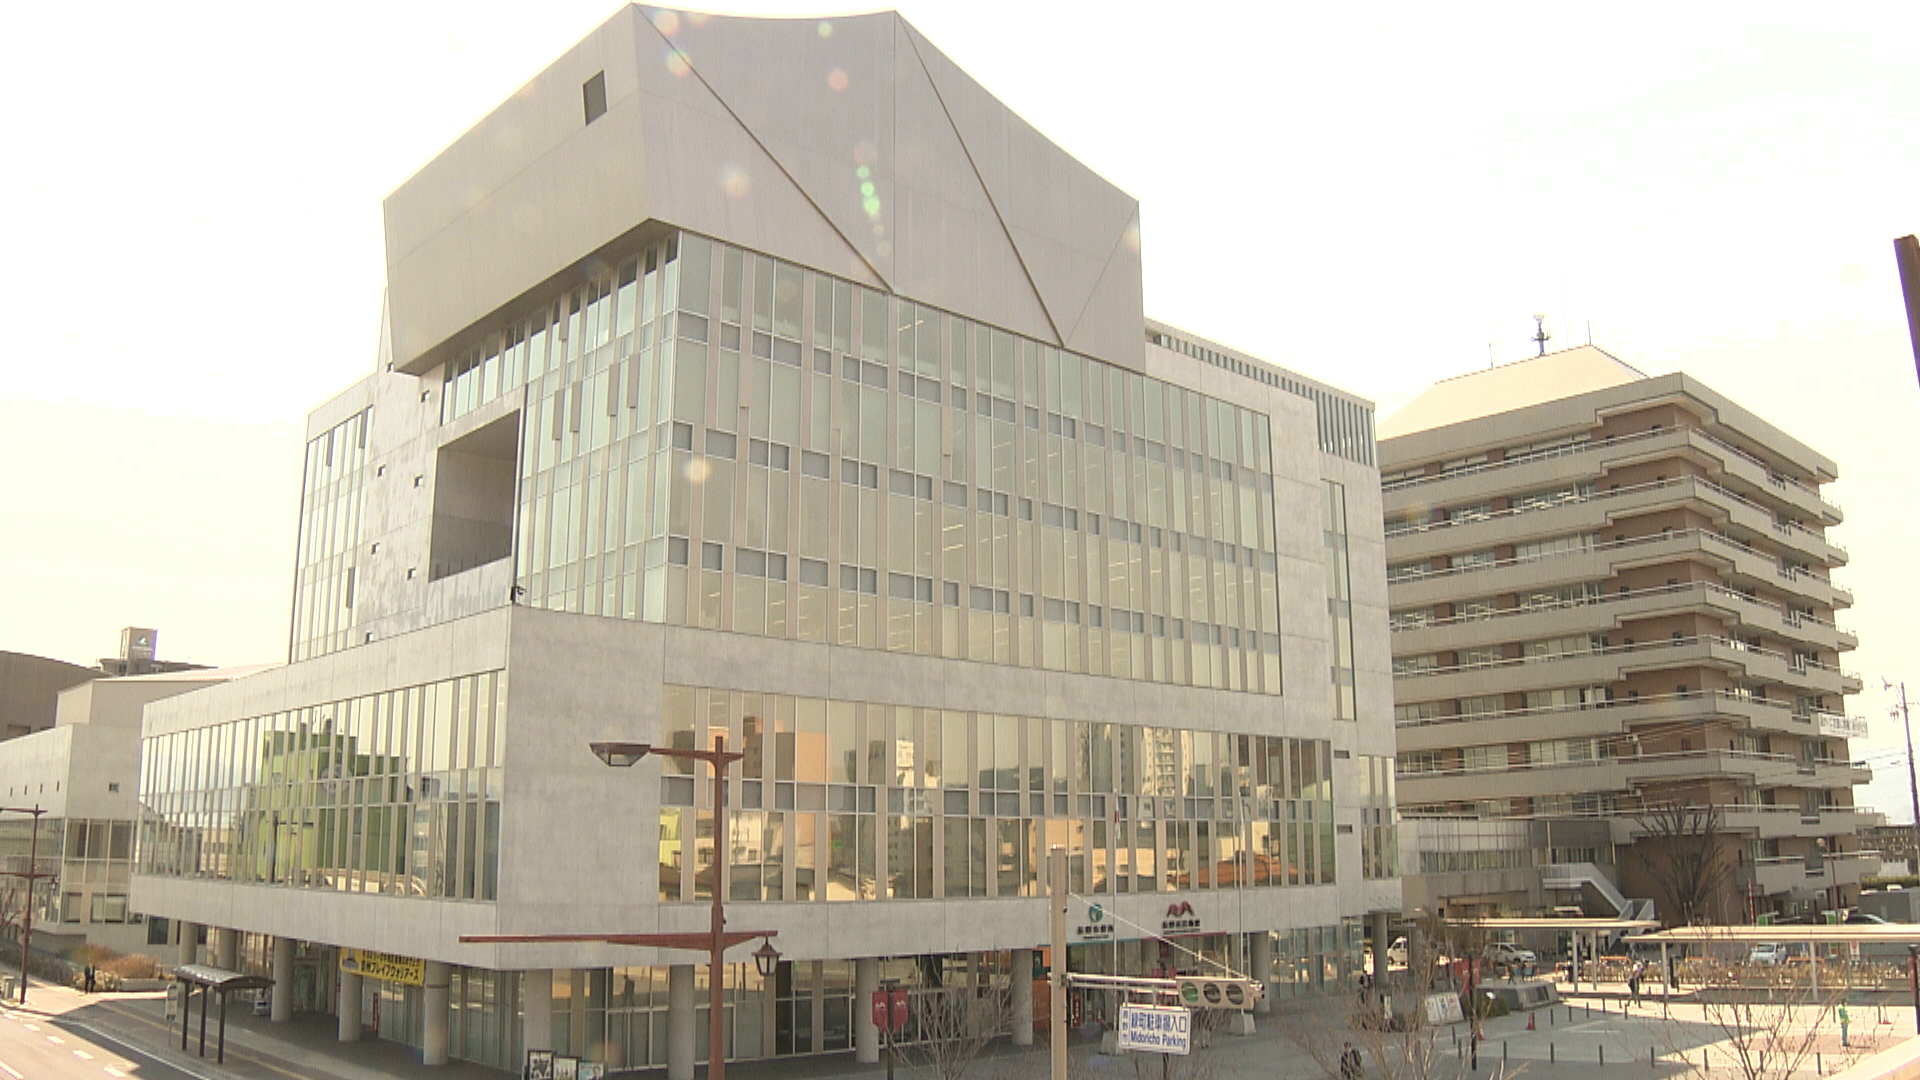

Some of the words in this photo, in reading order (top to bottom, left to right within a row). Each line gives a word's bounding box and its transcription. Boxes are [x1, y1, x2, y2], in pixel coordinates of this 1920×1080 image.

[1131, 1012, 1187, 1033] 緑町駐車場入口
[1130, 1030, 1160, 1045] Midoricho
[1162, 1034, 1186, 1049] Parking
